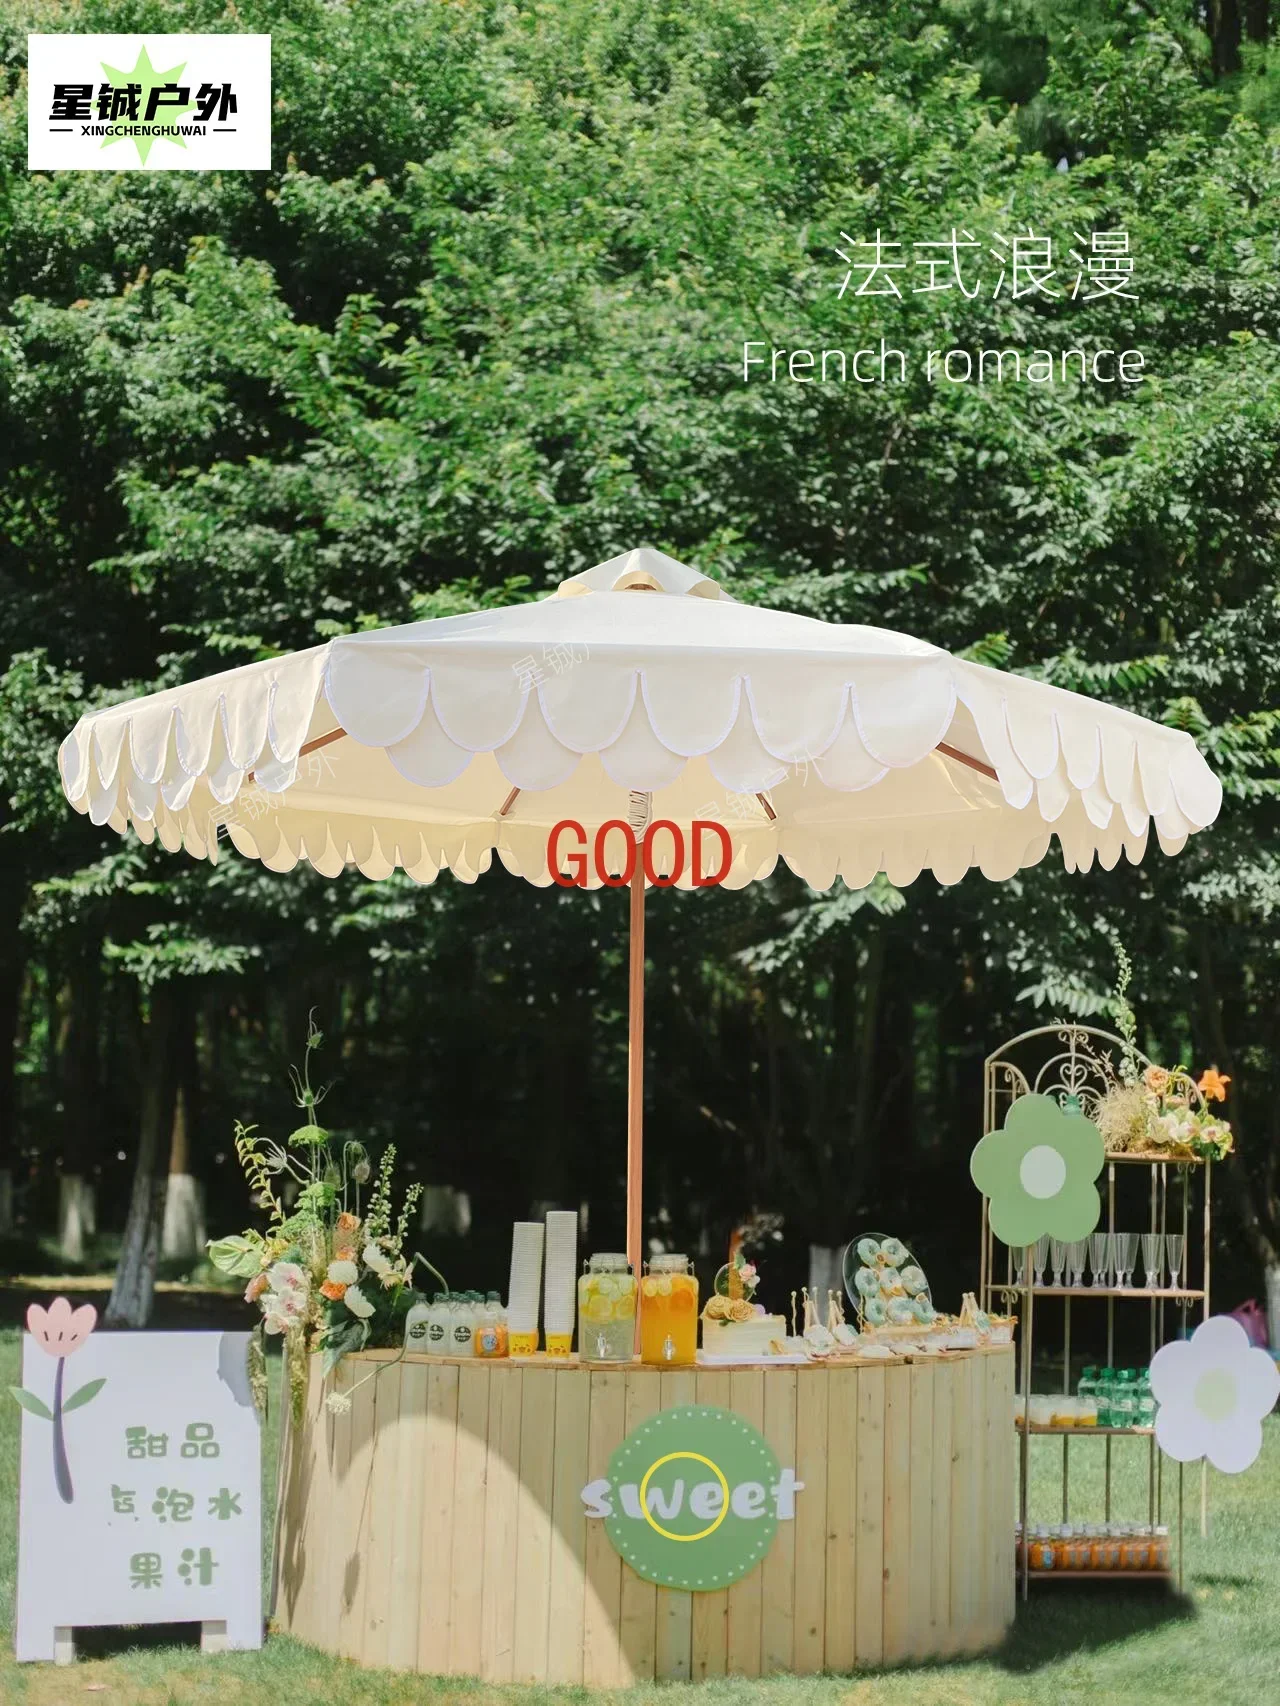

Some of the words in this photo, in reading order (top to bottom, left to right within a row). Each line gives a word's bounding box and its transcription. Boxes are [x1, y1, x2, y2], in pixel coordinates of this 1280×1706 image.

[125, 1422, 220, 1460] 甜品
[580, 1468, 805, 1520] sweet
[129, 1546, 219, 1589] 果汁
